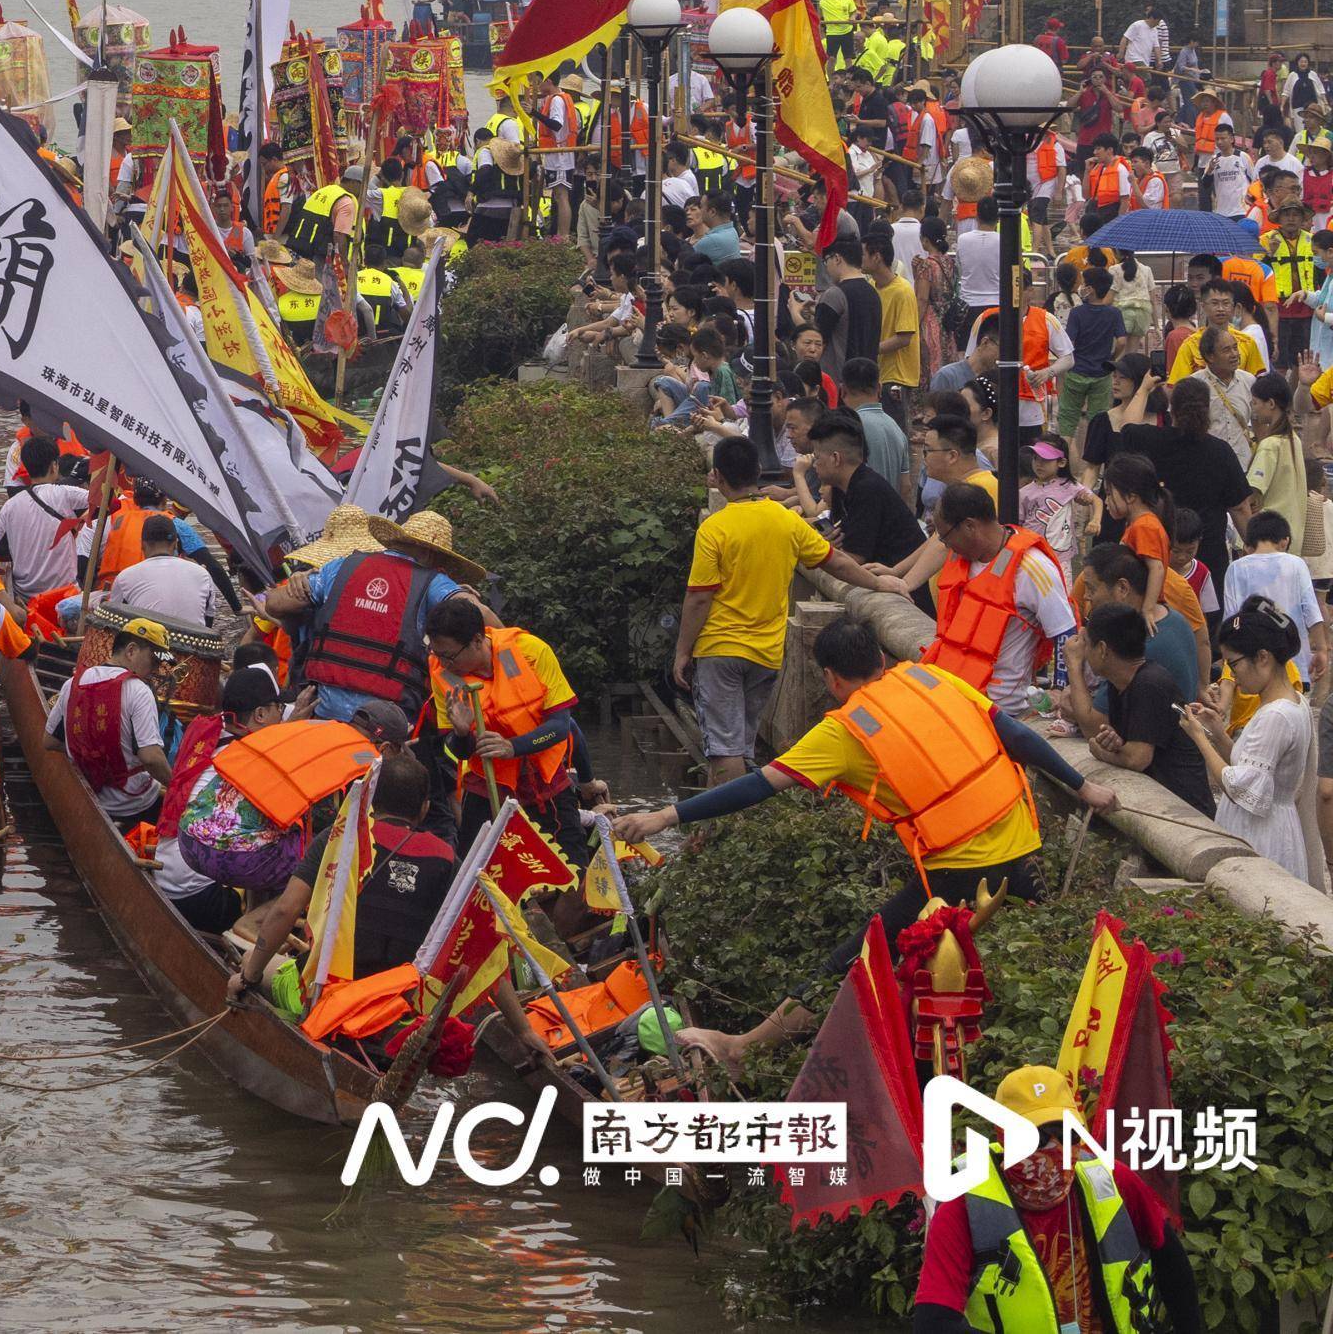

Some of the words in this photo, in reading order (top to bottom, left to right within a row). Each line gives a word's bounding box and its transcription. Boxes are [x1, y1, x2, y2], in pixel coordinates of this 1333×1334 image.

[40, 365, 208, 486] 珠海市弘星智能科技有限公司
[354, 597, 389, 614] YAMAHA
[1033, 1083, 1045, 1097] P
